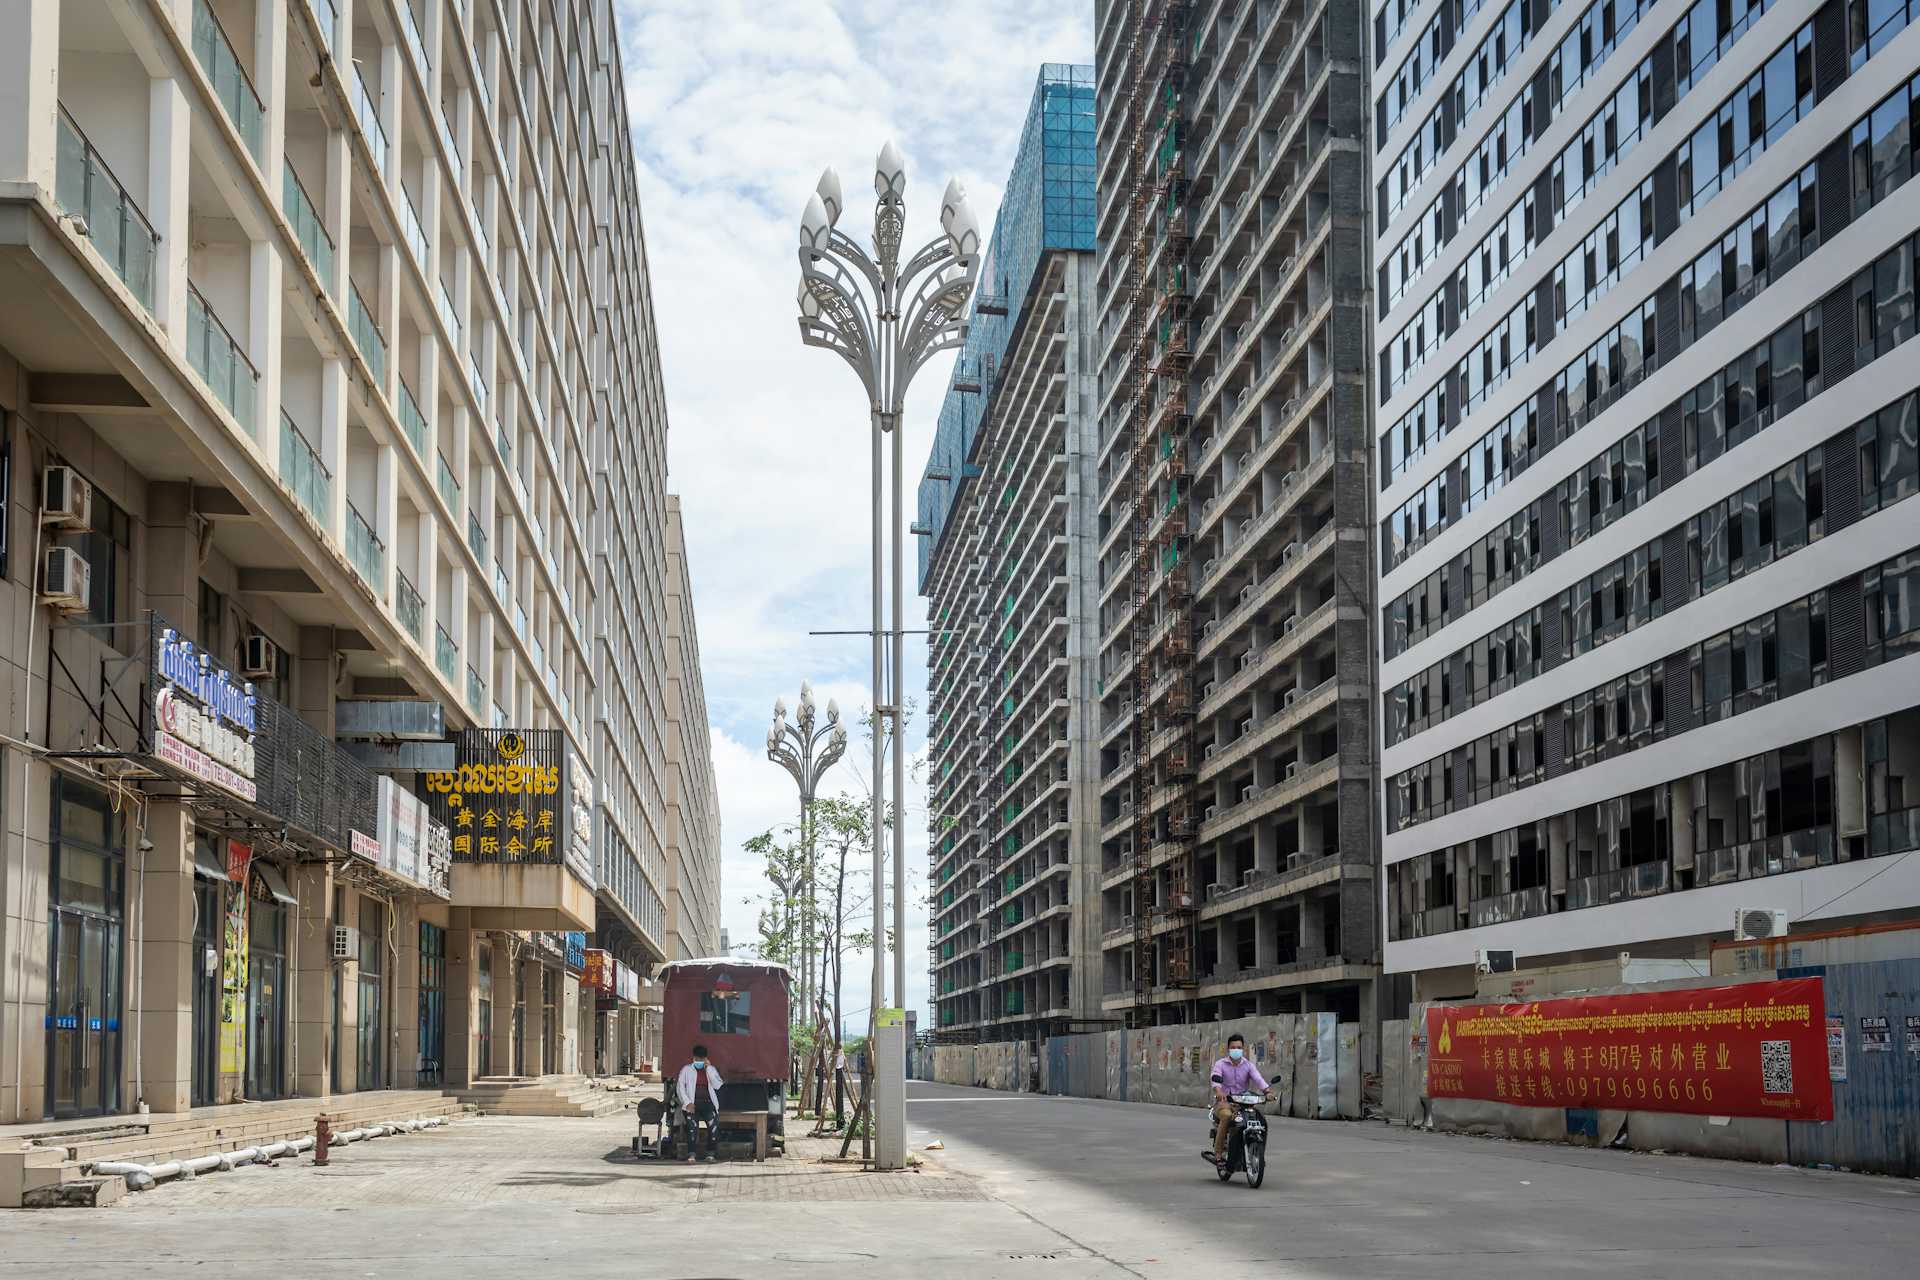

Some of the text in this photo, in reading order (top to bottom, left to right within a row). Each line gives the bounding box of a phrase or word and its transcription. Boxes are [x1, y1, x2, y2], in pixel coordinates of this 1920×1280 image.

[453, 807, 555, 833] 黄金海岸
[1480, 1041, 1732, 1073] 卡宾娱乐城 将于8月7号对外营业
